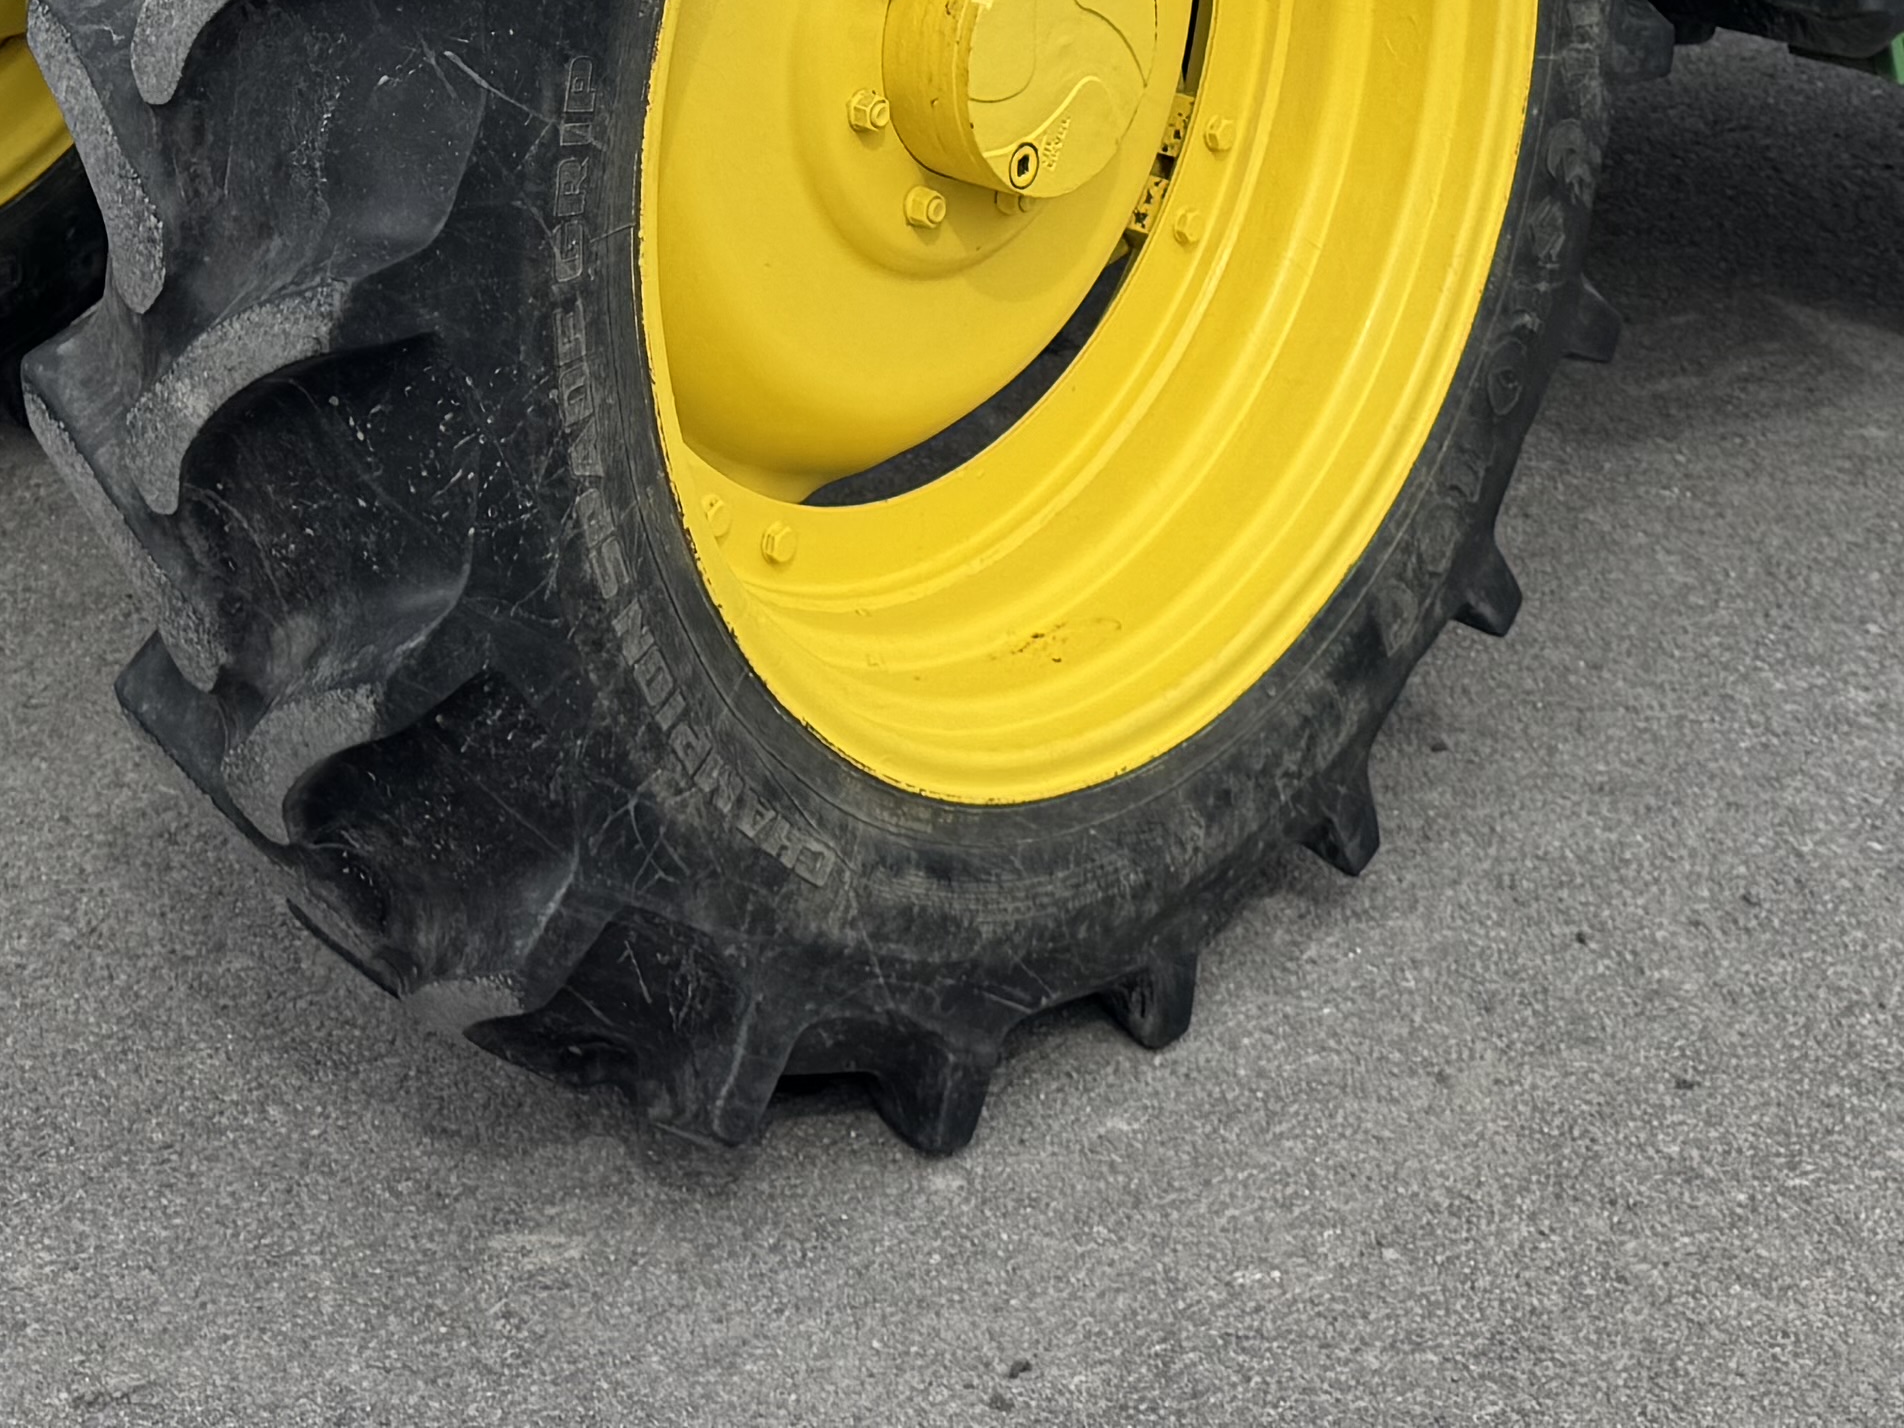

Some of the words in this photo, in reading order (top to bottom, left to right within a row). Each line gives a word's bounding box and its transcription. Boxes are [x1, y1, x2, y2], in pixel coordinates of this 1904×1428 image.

[552, 54, 595, 283] GRIP
[556, 296, 630, 600] SPADE
[611, 597, 836, 890] CHAMPION
